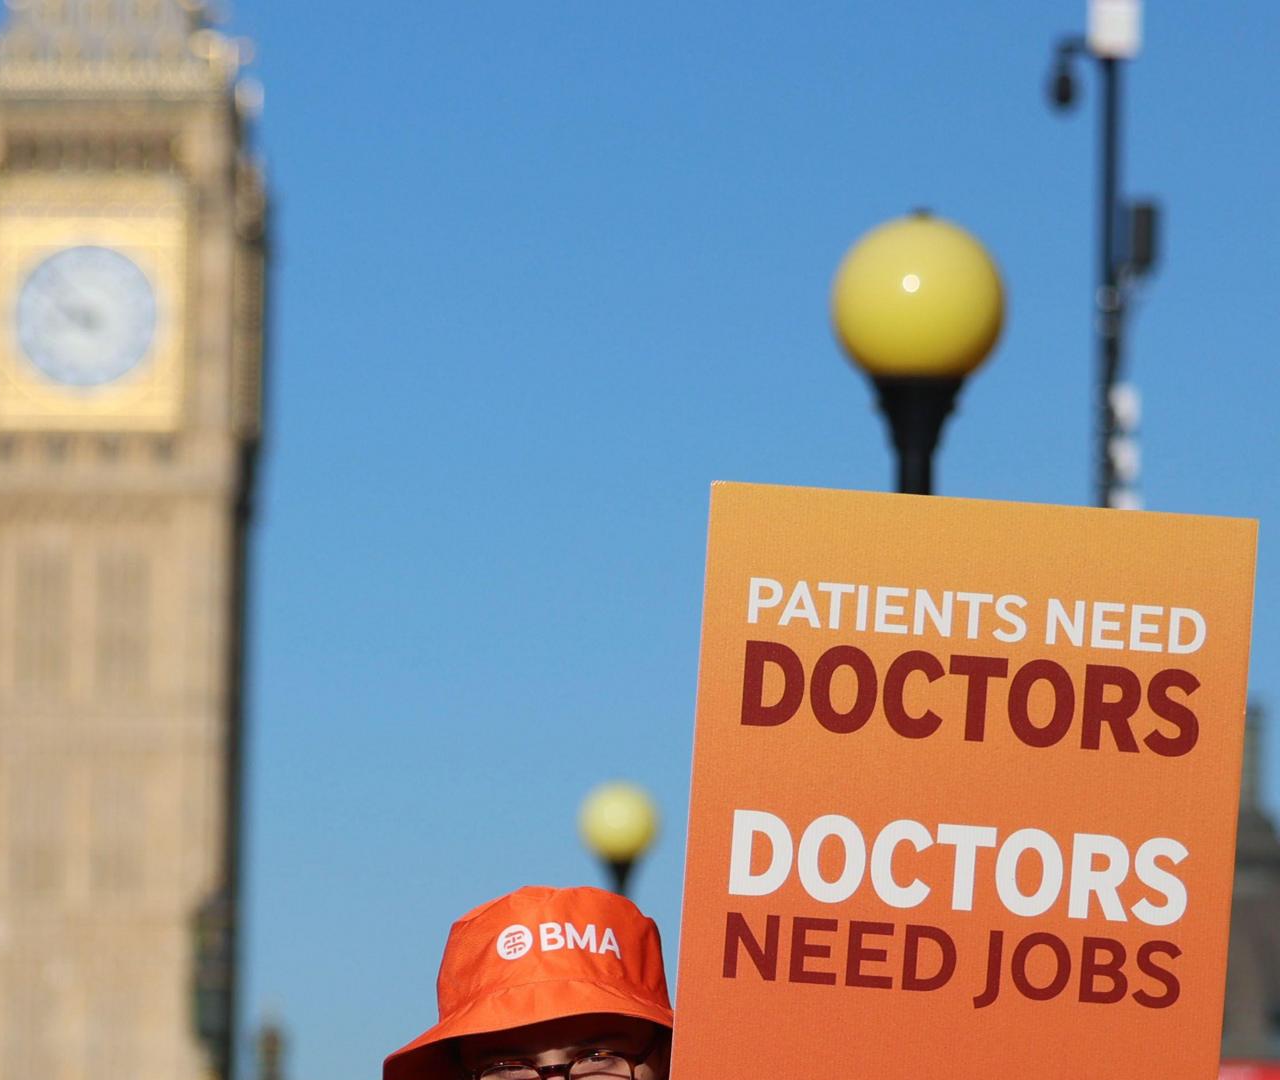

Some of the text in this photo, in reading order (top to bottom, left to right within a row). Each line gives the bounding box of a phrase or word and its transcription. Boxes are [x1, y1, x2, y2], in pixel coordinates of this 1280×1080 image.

[747, 577, 1208, 654] PATIENTS NEED
[740, 640, 1201, 757] DOCTORS
[728, 809, 1190, 926] DOCTORS
[540, 922, 621, 960] BMA
[722, 912, 1181, 1009] NEED JOBS
